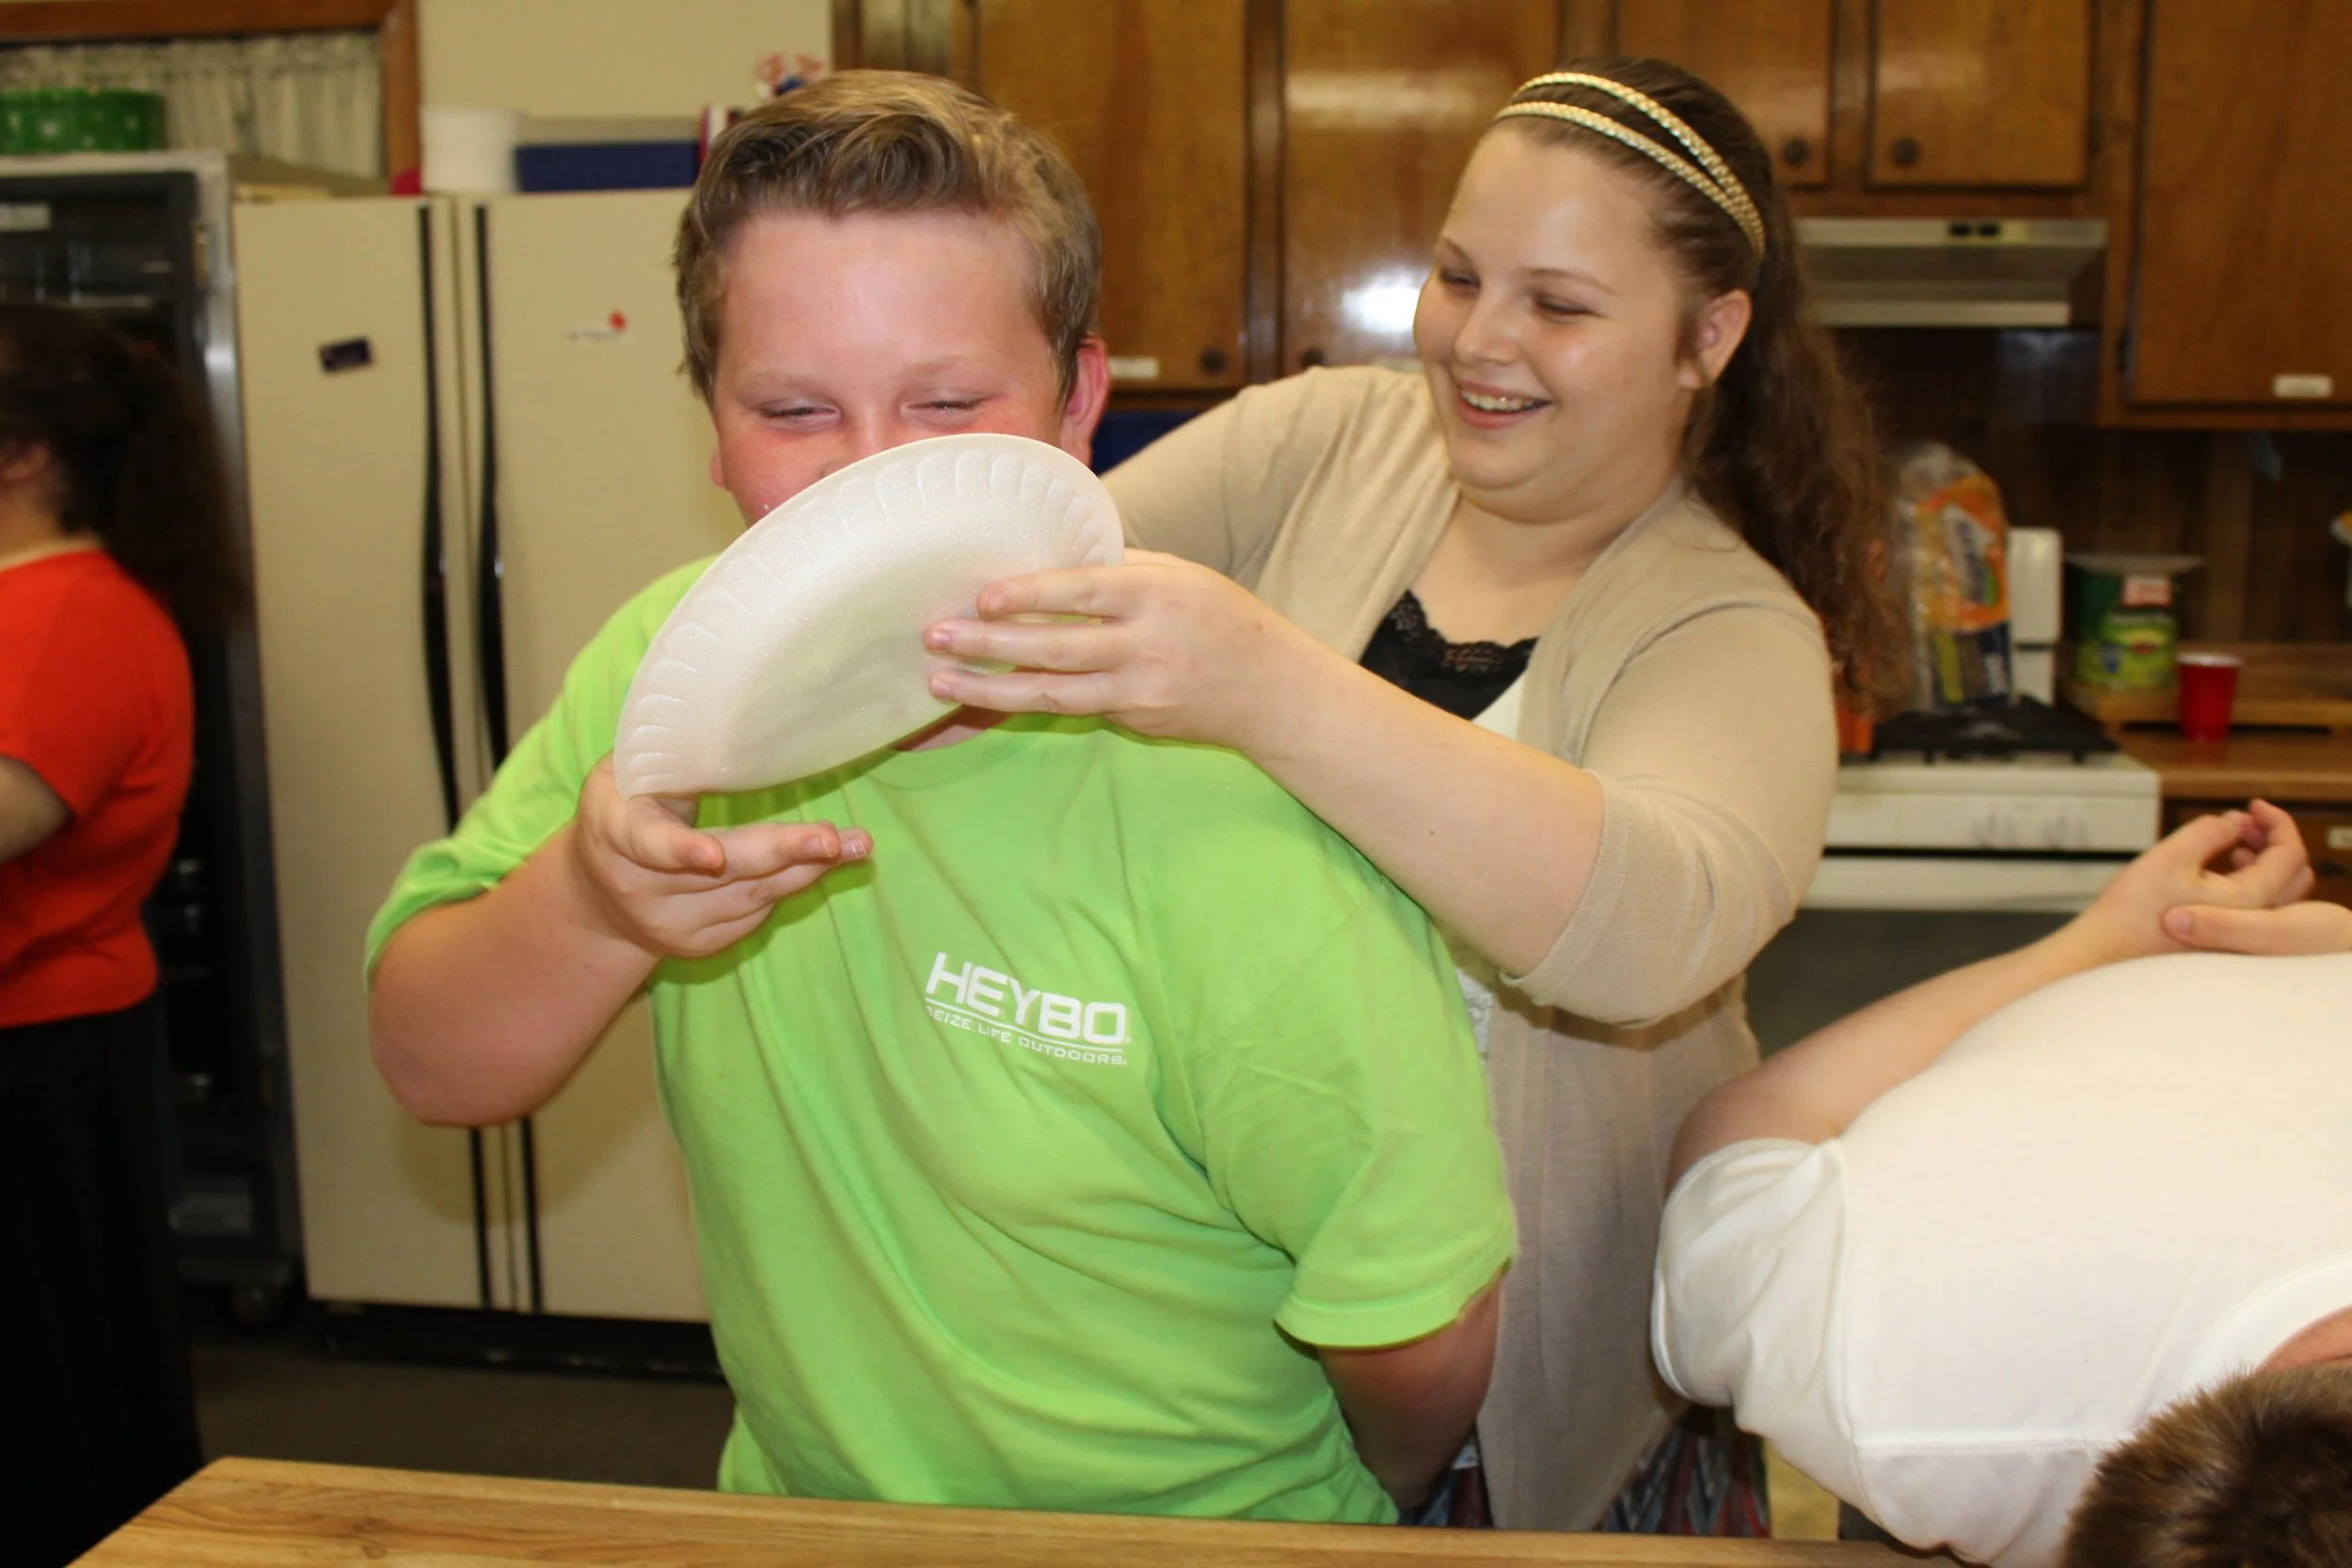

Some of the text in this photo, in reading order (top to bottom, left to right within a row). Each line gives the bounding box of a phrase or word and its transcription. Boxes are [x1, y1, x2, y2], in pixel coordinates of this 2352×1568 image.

[926, 951, 1126, 1045] HEYBO
[977, 1022, 1012, 1044] LIFE
[1018, 1036, 1123, 1065] OUTDOORS
